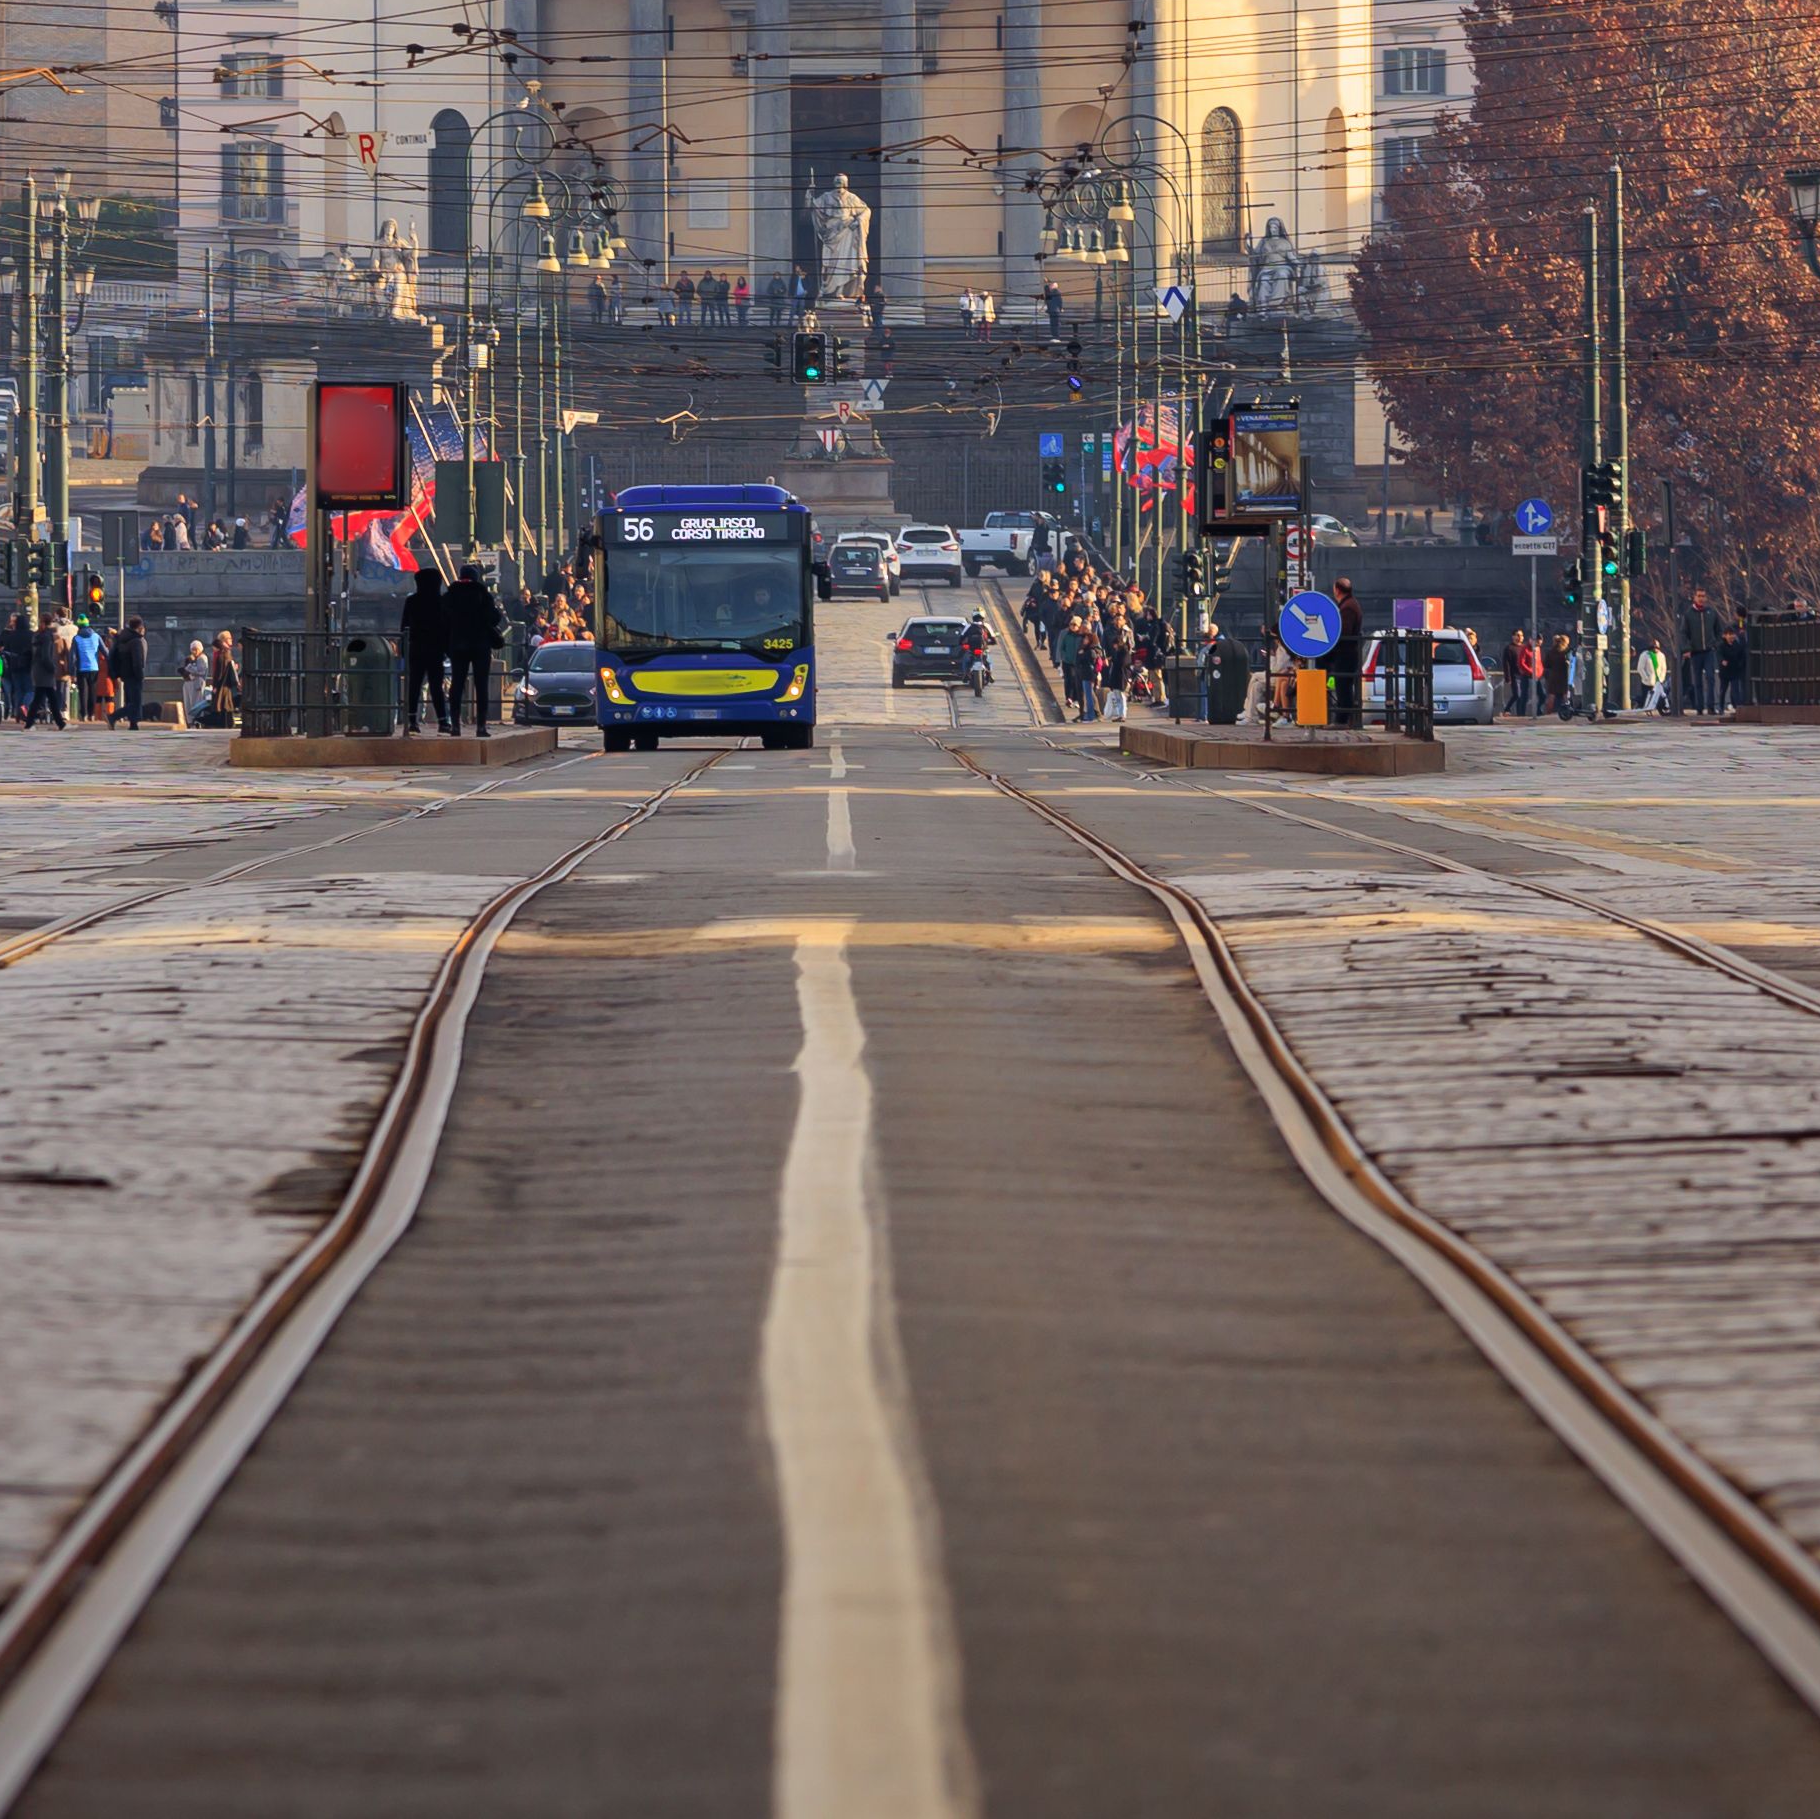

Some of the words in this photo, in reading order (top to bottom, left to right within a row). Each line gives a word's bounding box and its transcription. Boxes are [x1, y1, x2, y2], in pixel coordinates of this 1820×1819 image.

[358, 134, 377, 164] R
[839, 402, 850, 417] R
[623, 517, 654, 541] 56
[680, 517, 756, 529] GRUGLIASCO
[671, 528, 712, 540] CORSO
[714, 527, 765, 539] TIRRENO
[763, 638, 794, 650] 3425
